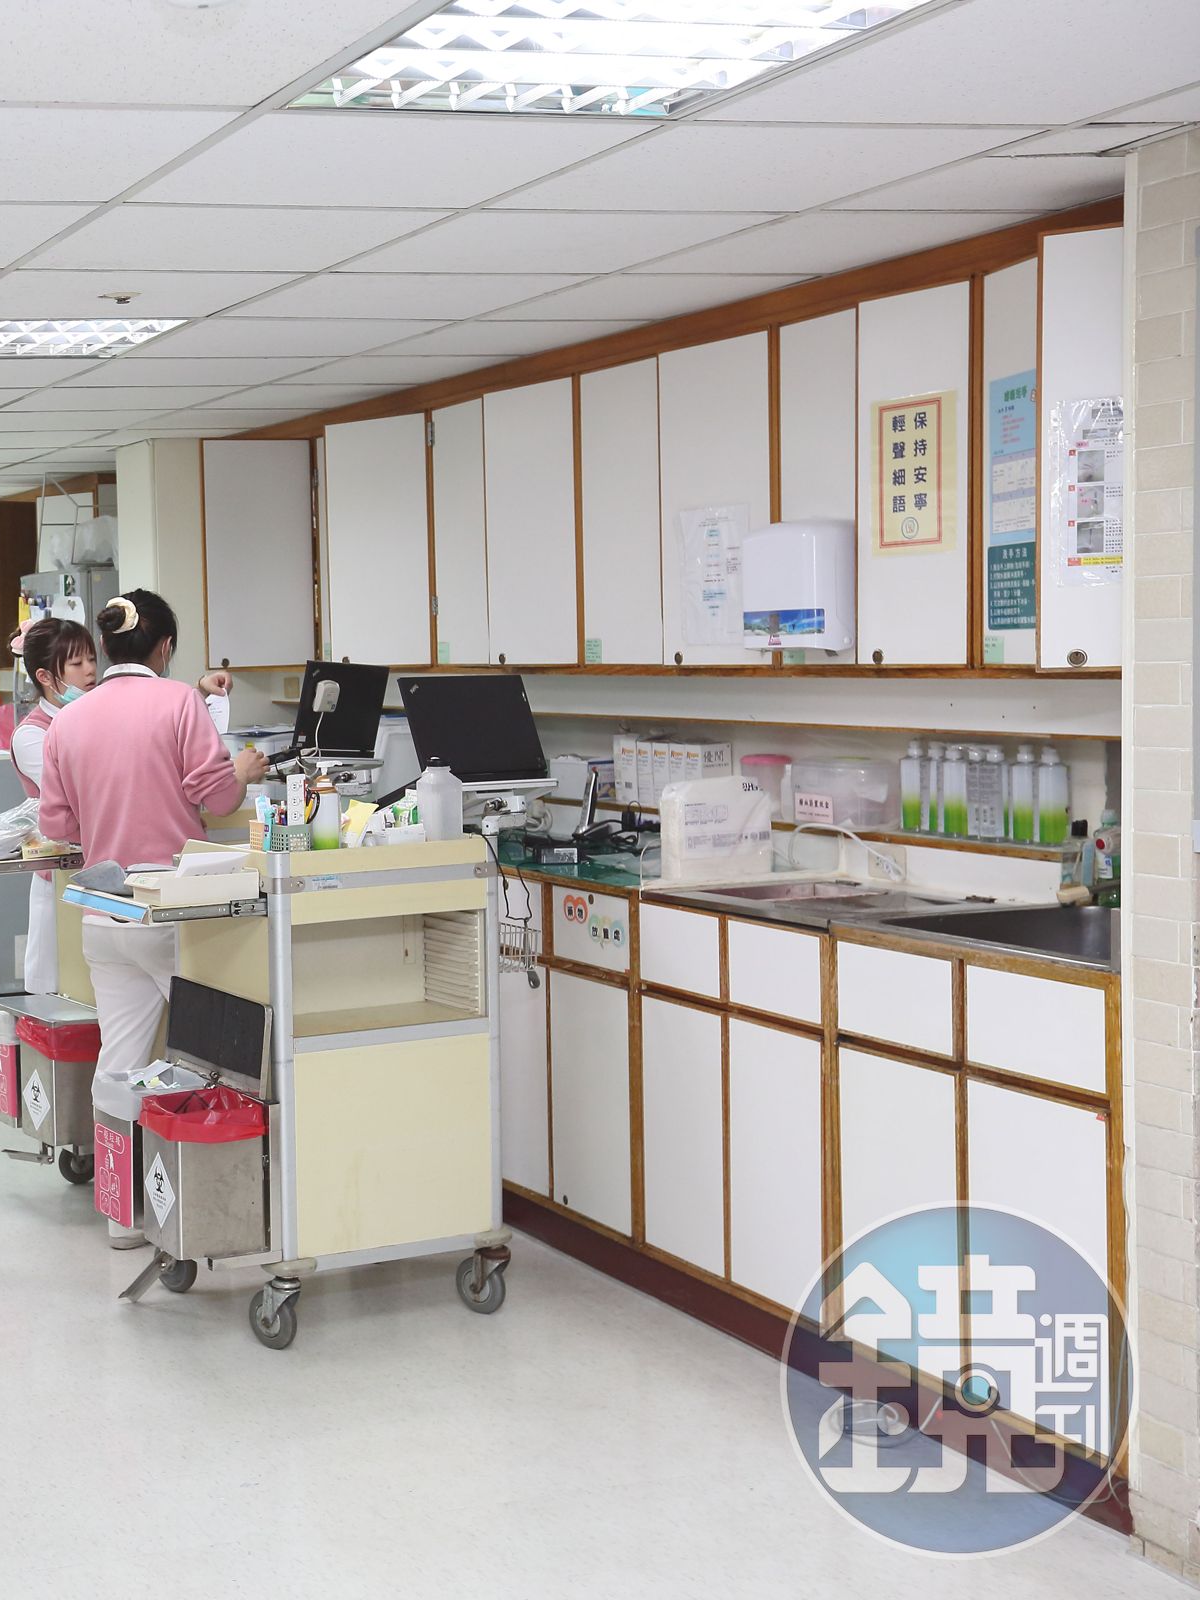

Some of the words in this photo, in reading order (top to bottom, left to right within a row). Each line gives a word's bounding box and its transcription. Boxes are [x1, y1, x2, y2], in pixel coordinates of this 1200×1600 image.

[891, 414, 906, 514] 輕聲細語
[913, 411, 928, 511] 保持安寧
[591, 925, 621, 942] 放置處
